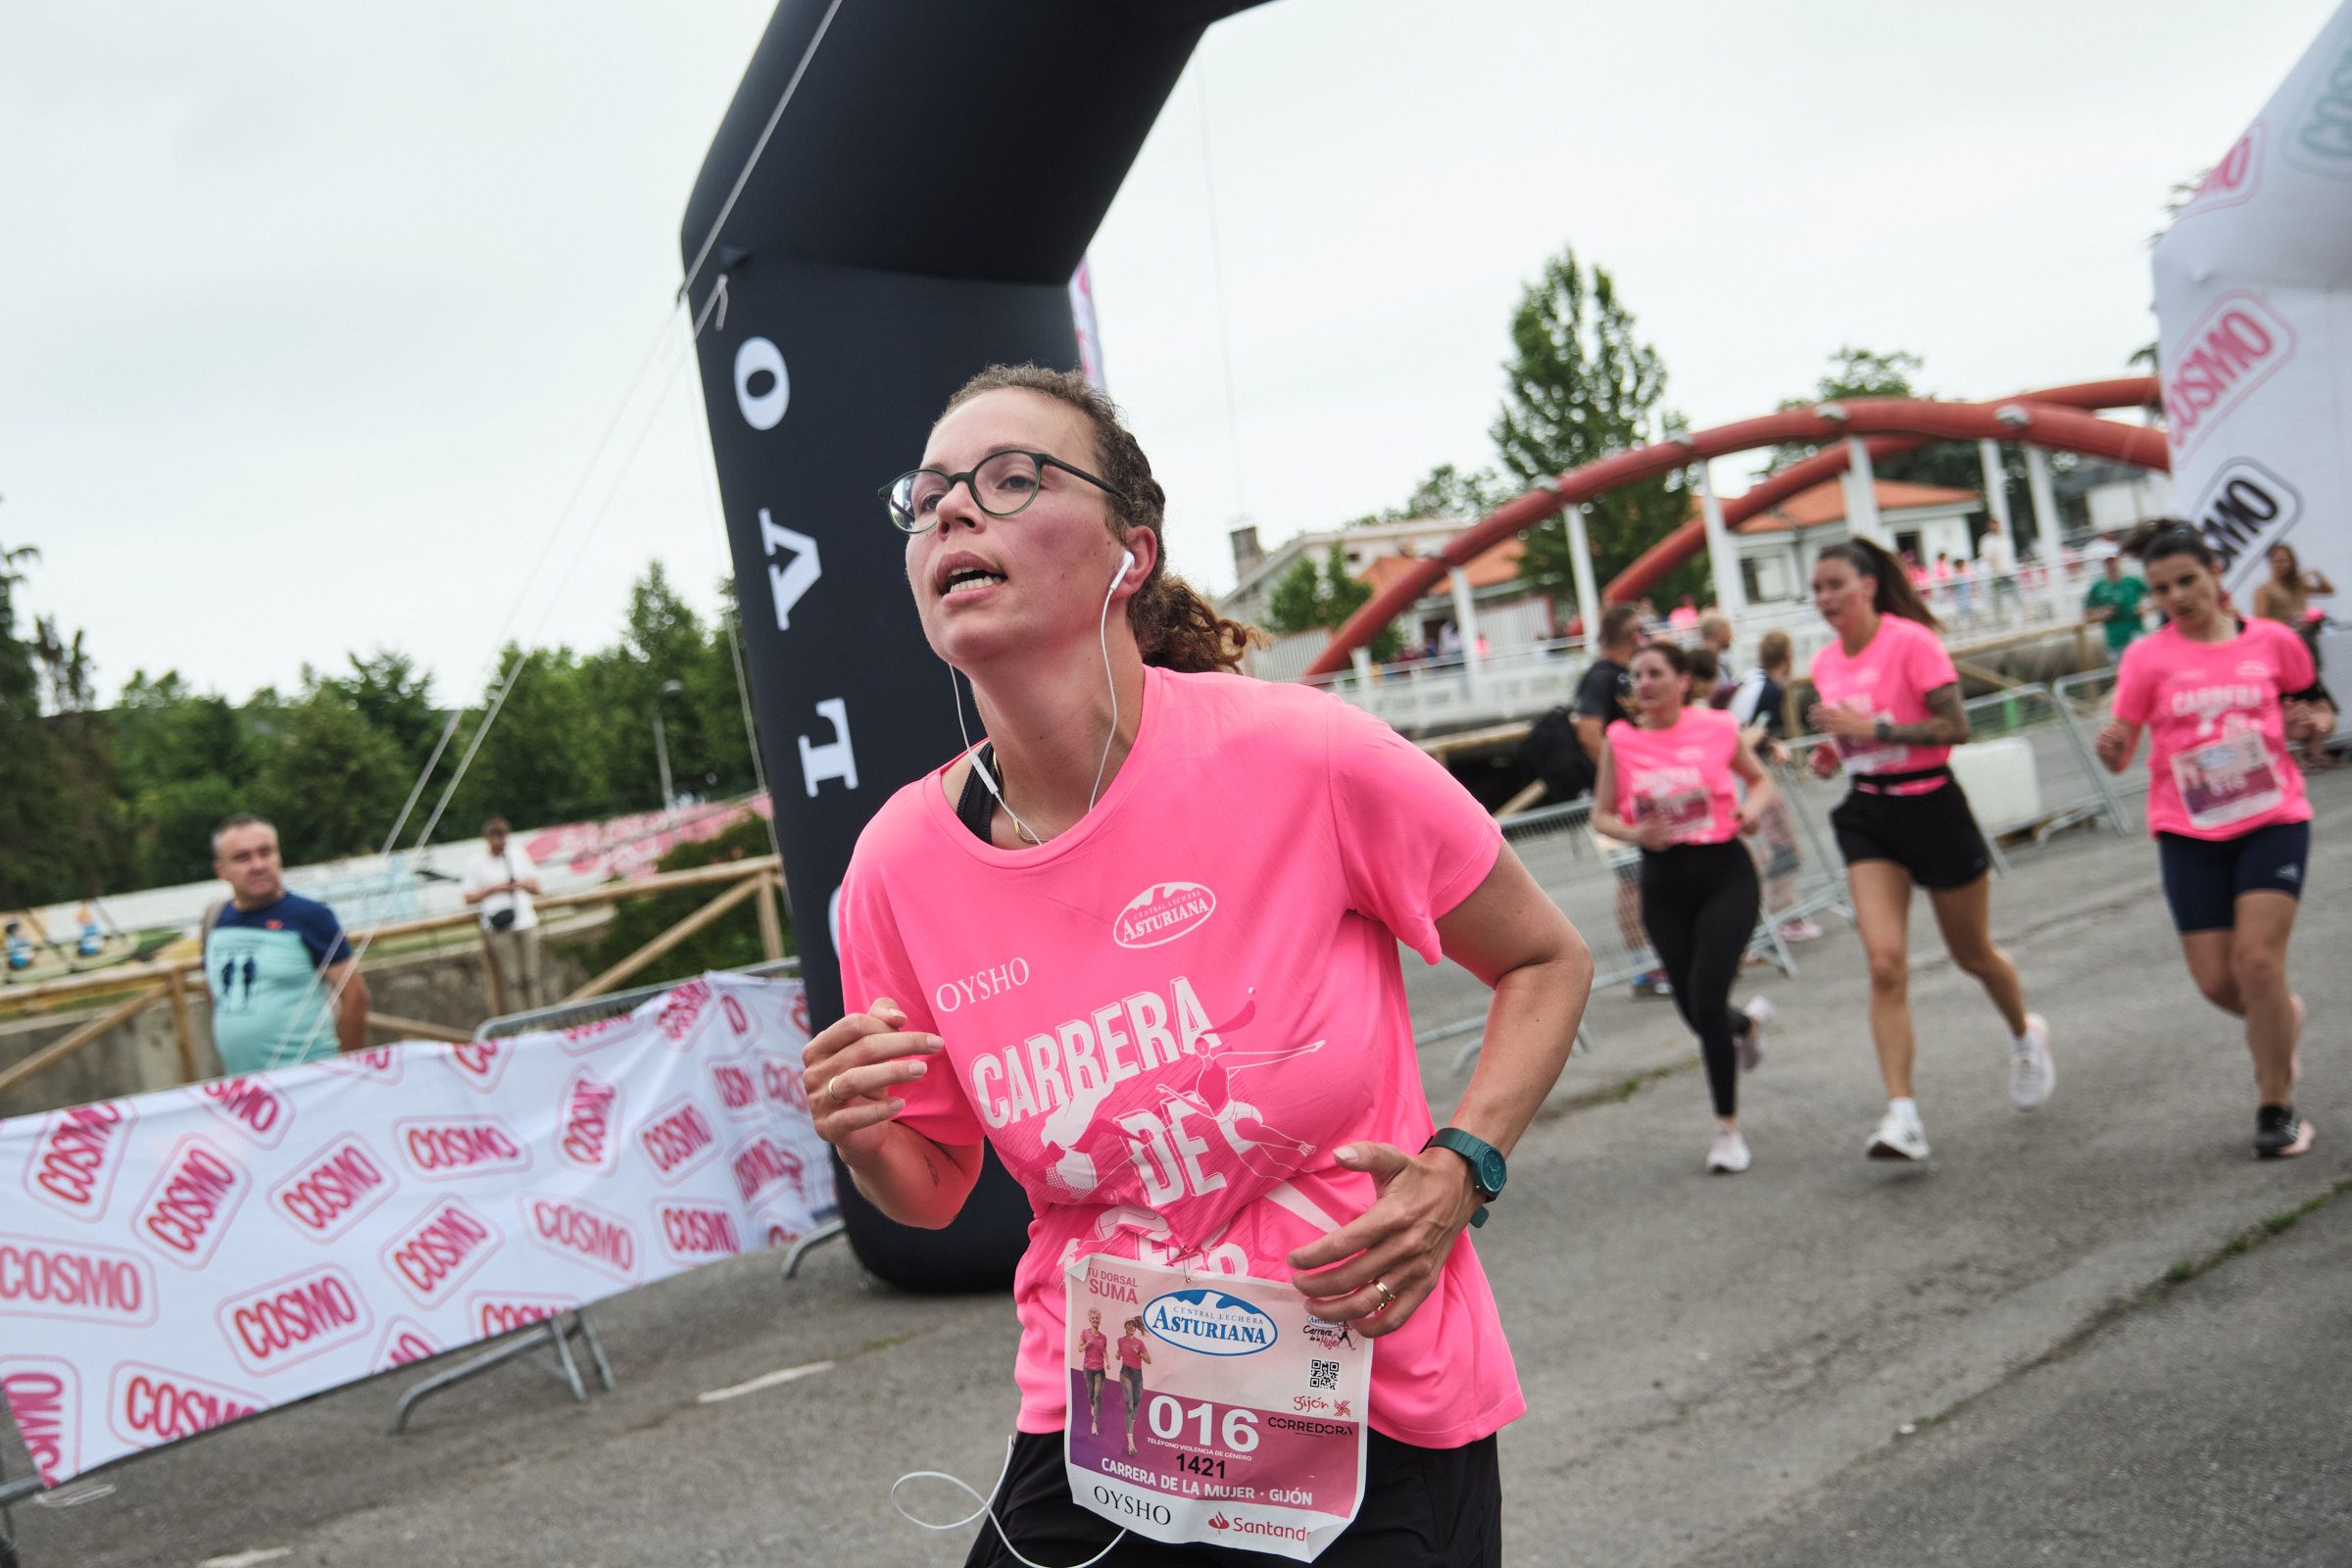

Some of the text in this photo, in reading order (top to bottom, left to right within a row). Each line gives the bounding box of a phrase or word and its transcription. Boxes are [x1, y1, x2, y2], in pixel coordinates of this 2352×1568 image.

[1122, 898, 1210, 944] ASTURIANA
[935, 956, 1030, 1013] OYSHO
[969, 976, 1223, 1130] CARRERA
[407, 1127, 519, 1170] COSMO
[1113, 1093, 1228, 1207] DE
[146, 1148, 236, 1254] COSMO
[281, 1145, 383, 1231] COSMO
[393, 1206, 489, 1293] COSMO
[533, 1200, 634, 1272] COSMO
[0, 1246, 141, 1313] COSMO
[1089, 1278, 1139, 1305] SUMA
[1100, 1270, 1139, 1288] DORSAL
[233, 1276, 357, 1358] COSMO
[1152, 1304, 1268, 1346] ASTURIANA
[1173, 1304, 1264, 1325] CENTRAL LECHERA
[1148, 1394, 1260, 1453] 016
[1293, 1395, 1329, 1413] gijón
[1146, 1436, 1179, 1449] TELÉFONO
[1179, 1444, 1214, 1456] VIOLENCIA
[1224, 1451, 1252, 1462] GÉNERO
[1176, 1453, 1226, 1480] 1421
[1093, 1485, 1172, 1527] OYSHO
[1101, 1456, 1313, 1506] CARRERA DE LA MUJER GIJÓN
